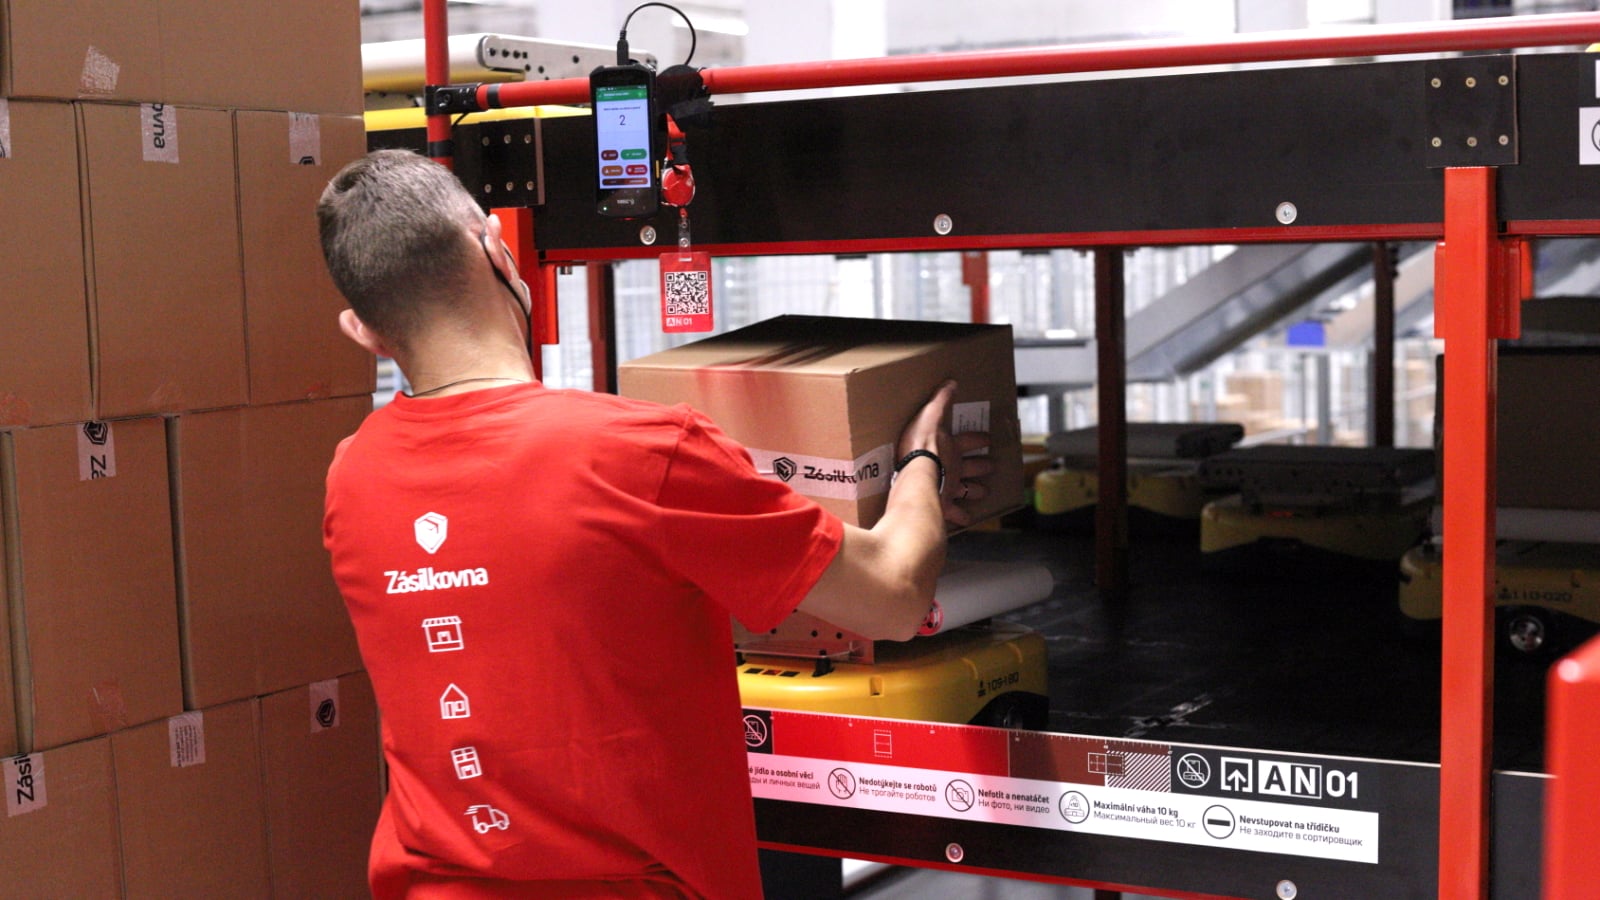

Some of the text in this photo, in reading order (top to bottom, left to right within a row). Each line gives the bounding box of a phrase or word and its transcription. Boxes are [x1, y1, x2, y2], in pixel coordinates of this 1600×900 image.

[619, 114, 626, 126] 2
[384, 567, 489, 594] Zásilkovna
[754, 766, 770, 777] jídlo
[775, 769, 798, 779] osobní
[799, 771, 814, 780] věci
[858, 777, 937, 792] Nedotýkejte se robotů
[858, 786, 936, 802] Не трогайте роботов
[978, 788, 1004, 800] Nefotit
[1011, 793, 1050, 804] nenatáčet
[978, 798, 989, 807] Ни
[991, 799, 1013, 811] фото,
[1026, 805, 1050, 814] видео
[1093, 800, 1179, 818] Maximální váha 10 kg
[1093, 810, 1197, 829] Максимальный вес 10 кг
[1239, 815, 1340, 833] Nevstupovat na třídičku
[1239, 825, 1363, 847] Не заходите в сортировщик
